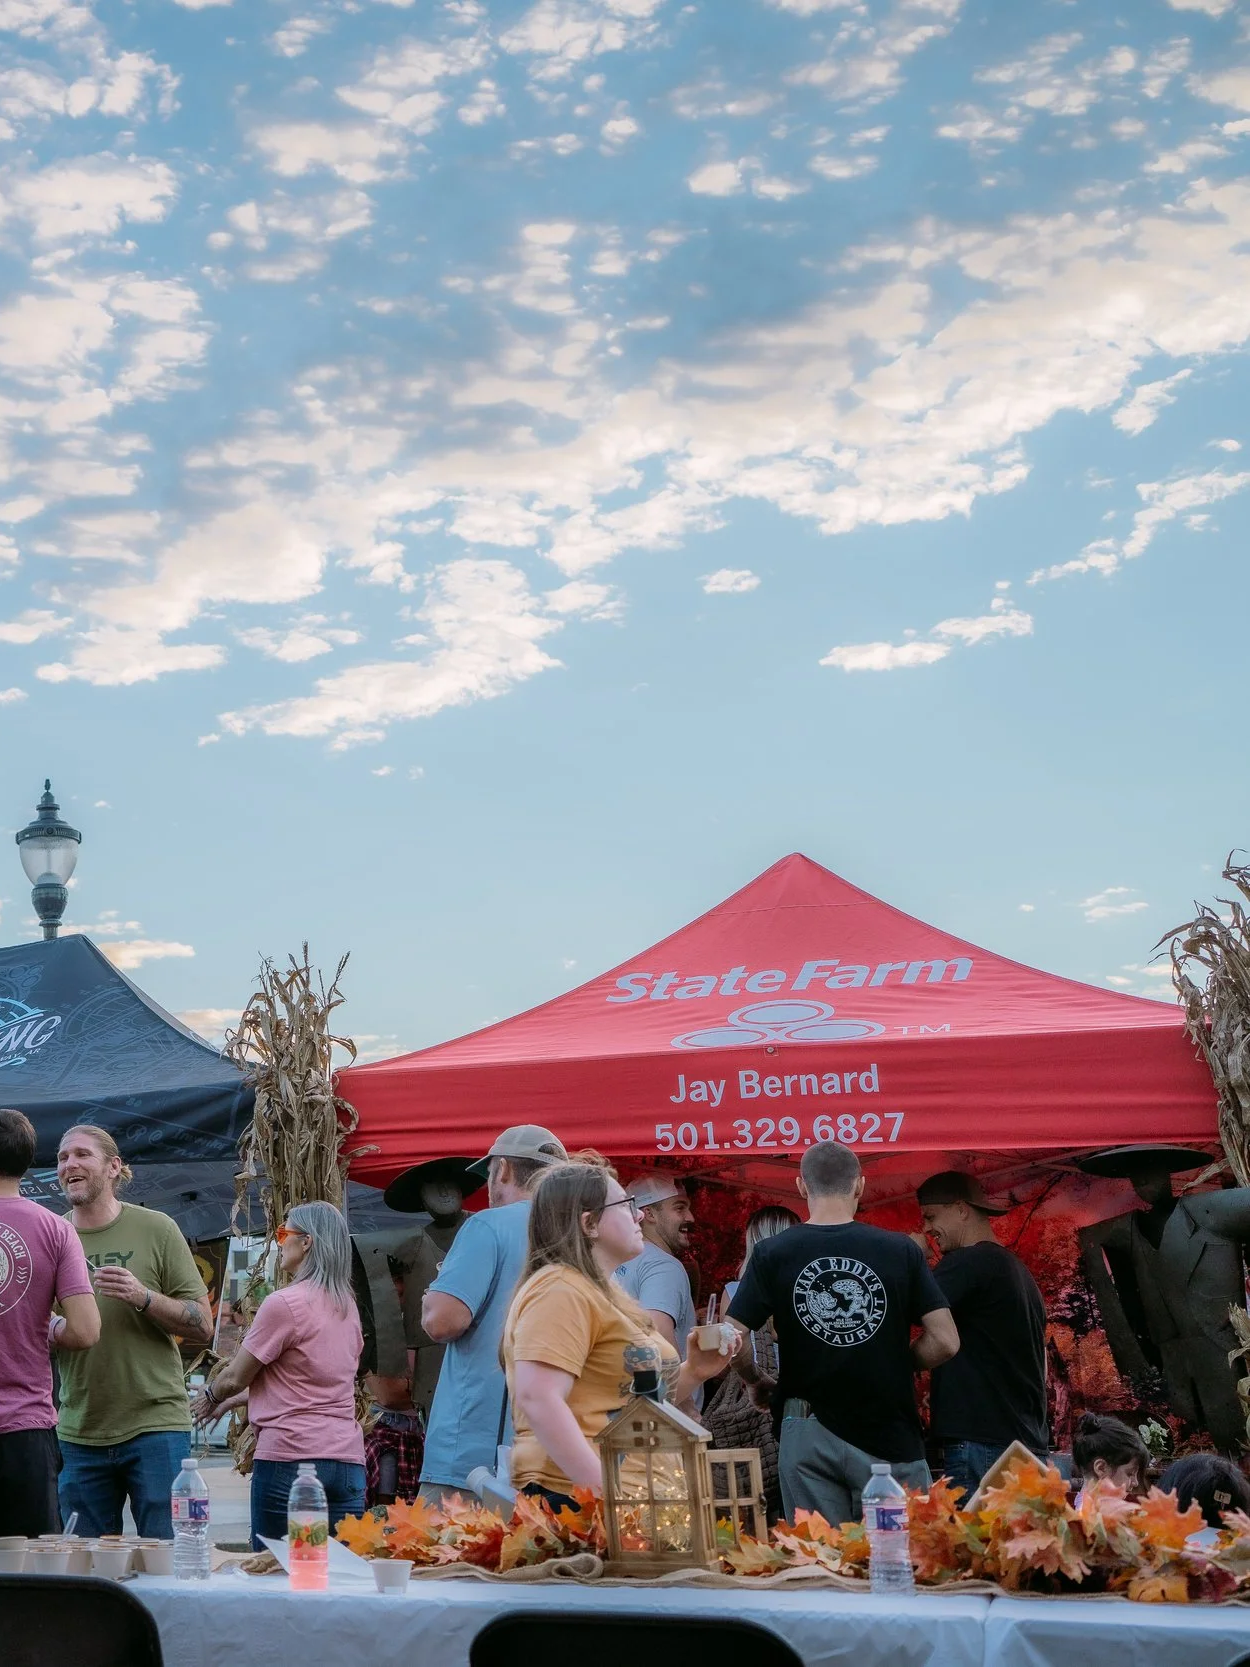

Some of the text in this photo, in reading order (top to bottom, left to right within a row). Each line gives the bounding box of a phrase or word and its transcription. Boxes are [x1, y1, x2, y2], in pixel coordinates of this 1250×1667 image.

[669, 1063, 881, 1108] Jay Bernard
[654, 1111, 906, 1152] 501.329.6827
[0, 1228, 27, 1260] BEACH
[795, 1257, 882, 1295] FAST EDDY'S
[796, 1297, 884, 1345] RESTAURANT
